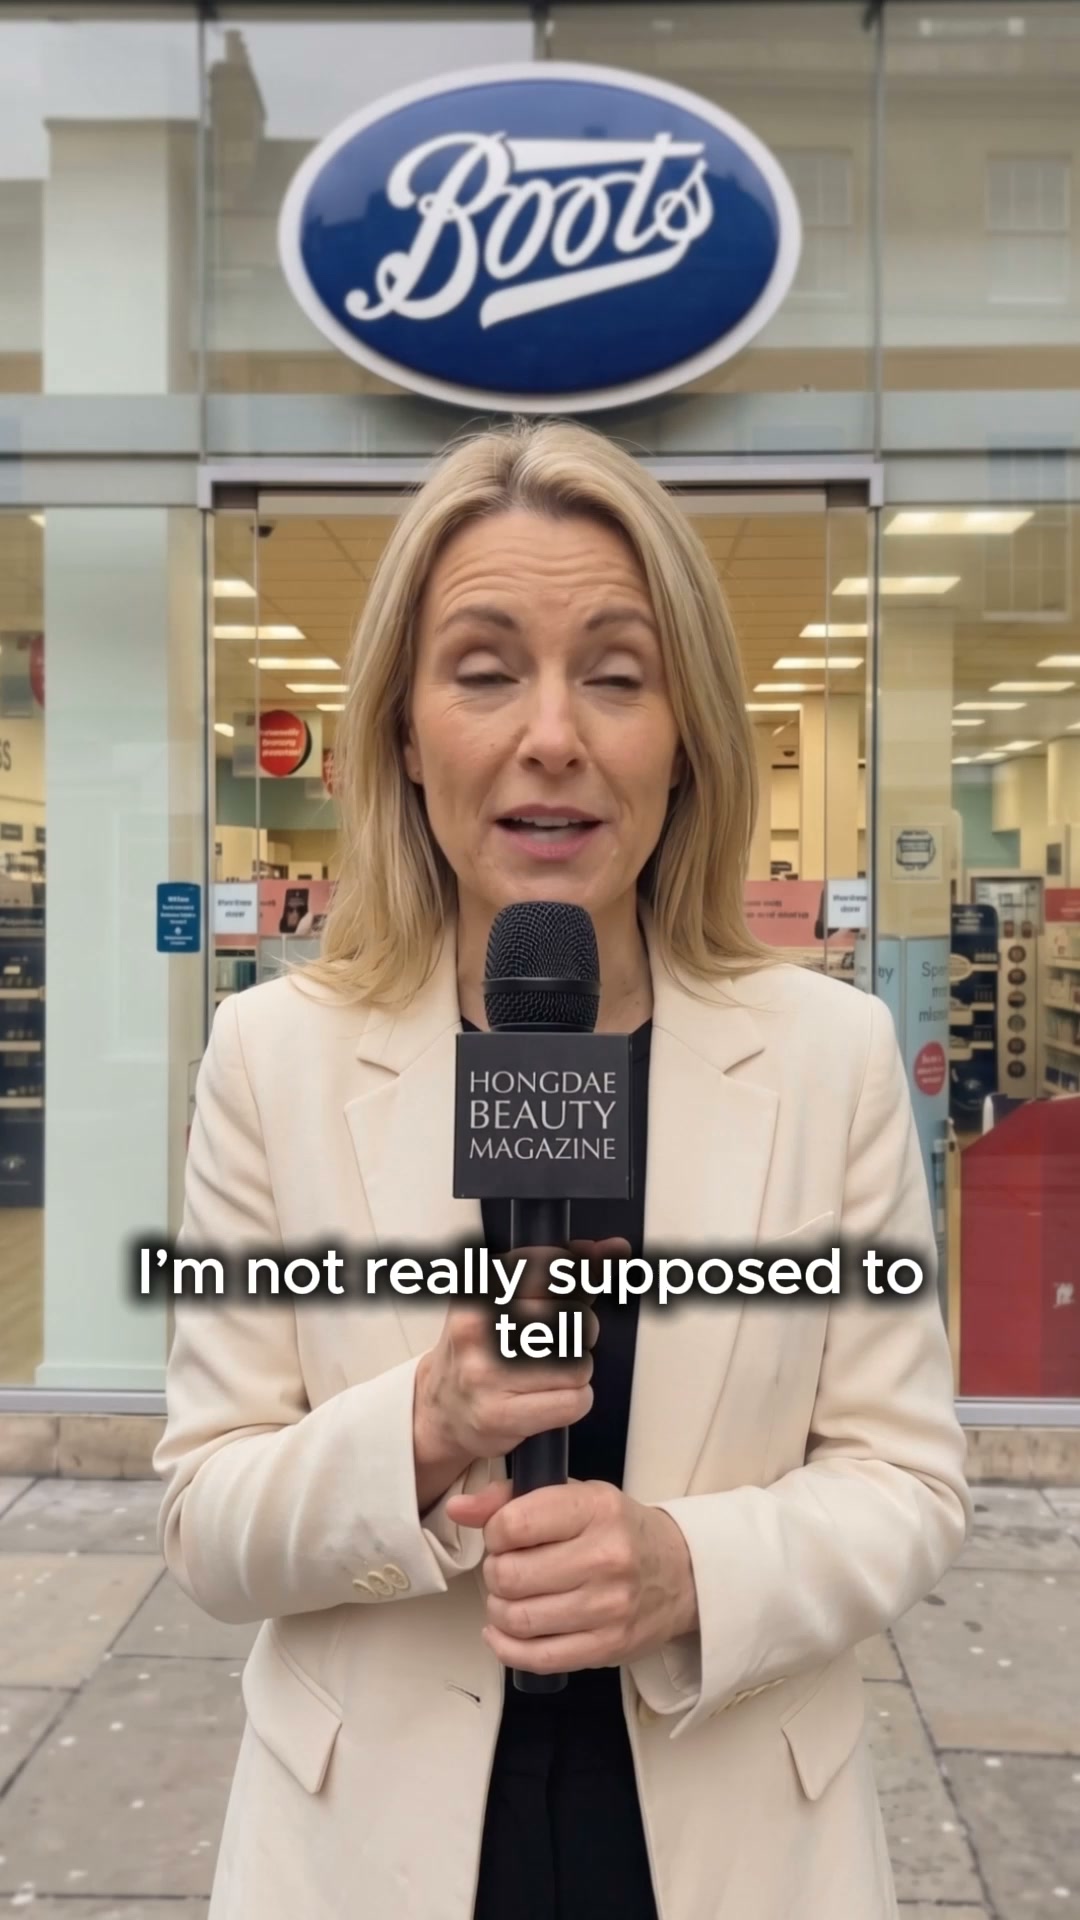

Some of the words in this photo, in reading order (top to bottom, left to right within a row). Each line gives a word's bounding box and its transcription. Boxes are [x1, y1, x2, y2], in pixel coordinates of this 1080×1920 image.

[344, 130, 715, 330] Boots
[0, 738, 12, 772] S
[469, 1070, 617, 1094] HONGDAE
[469, 1099, 617, 1130] BEAUTY
[468, 1136, 617, 1160] MAGAZINE
